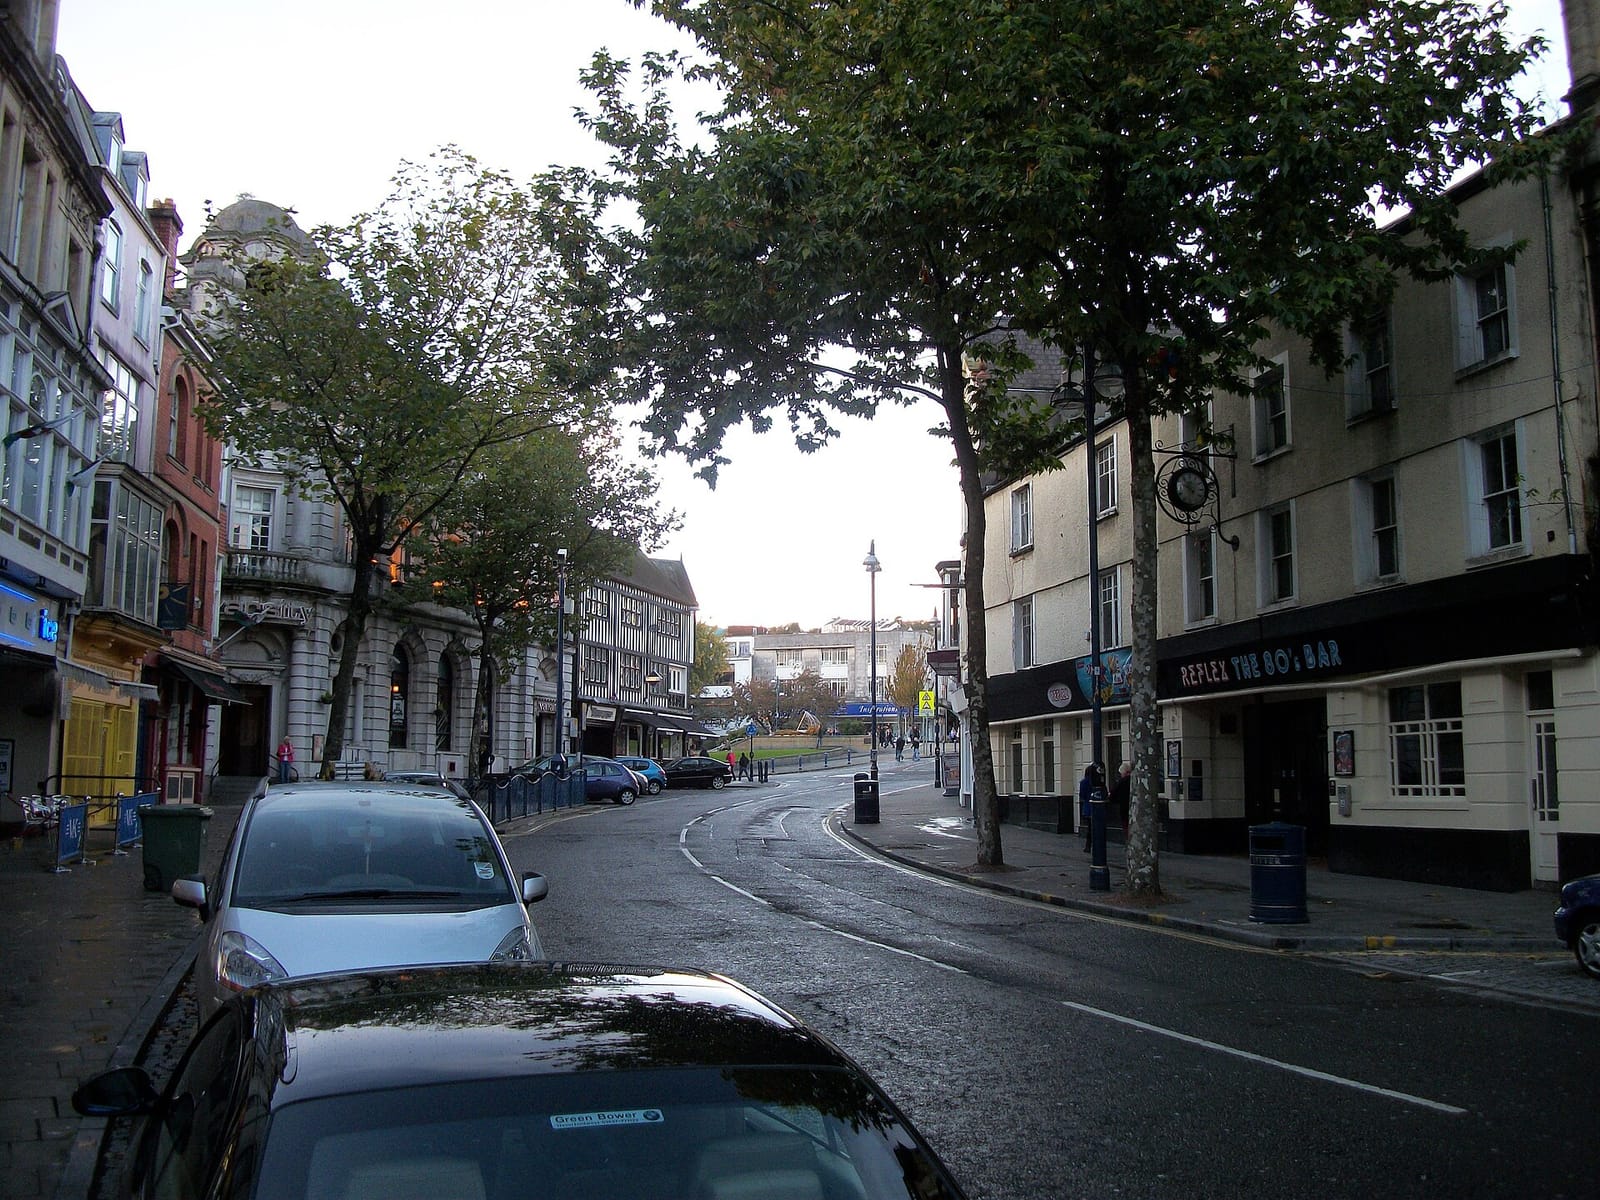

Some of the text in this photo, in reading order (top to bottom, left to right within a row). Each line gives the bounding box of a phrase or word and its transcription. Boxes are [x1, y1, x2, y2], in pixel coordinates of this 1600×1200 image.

[1180, 659, 1230, 688] REFLEX
[1230, 652, 1261, 682] THE
[1303, 639, 1343, 670] BAR
[555, 1115, 593, 1124] Green
[597, 1111, 637, 1121] Bower
